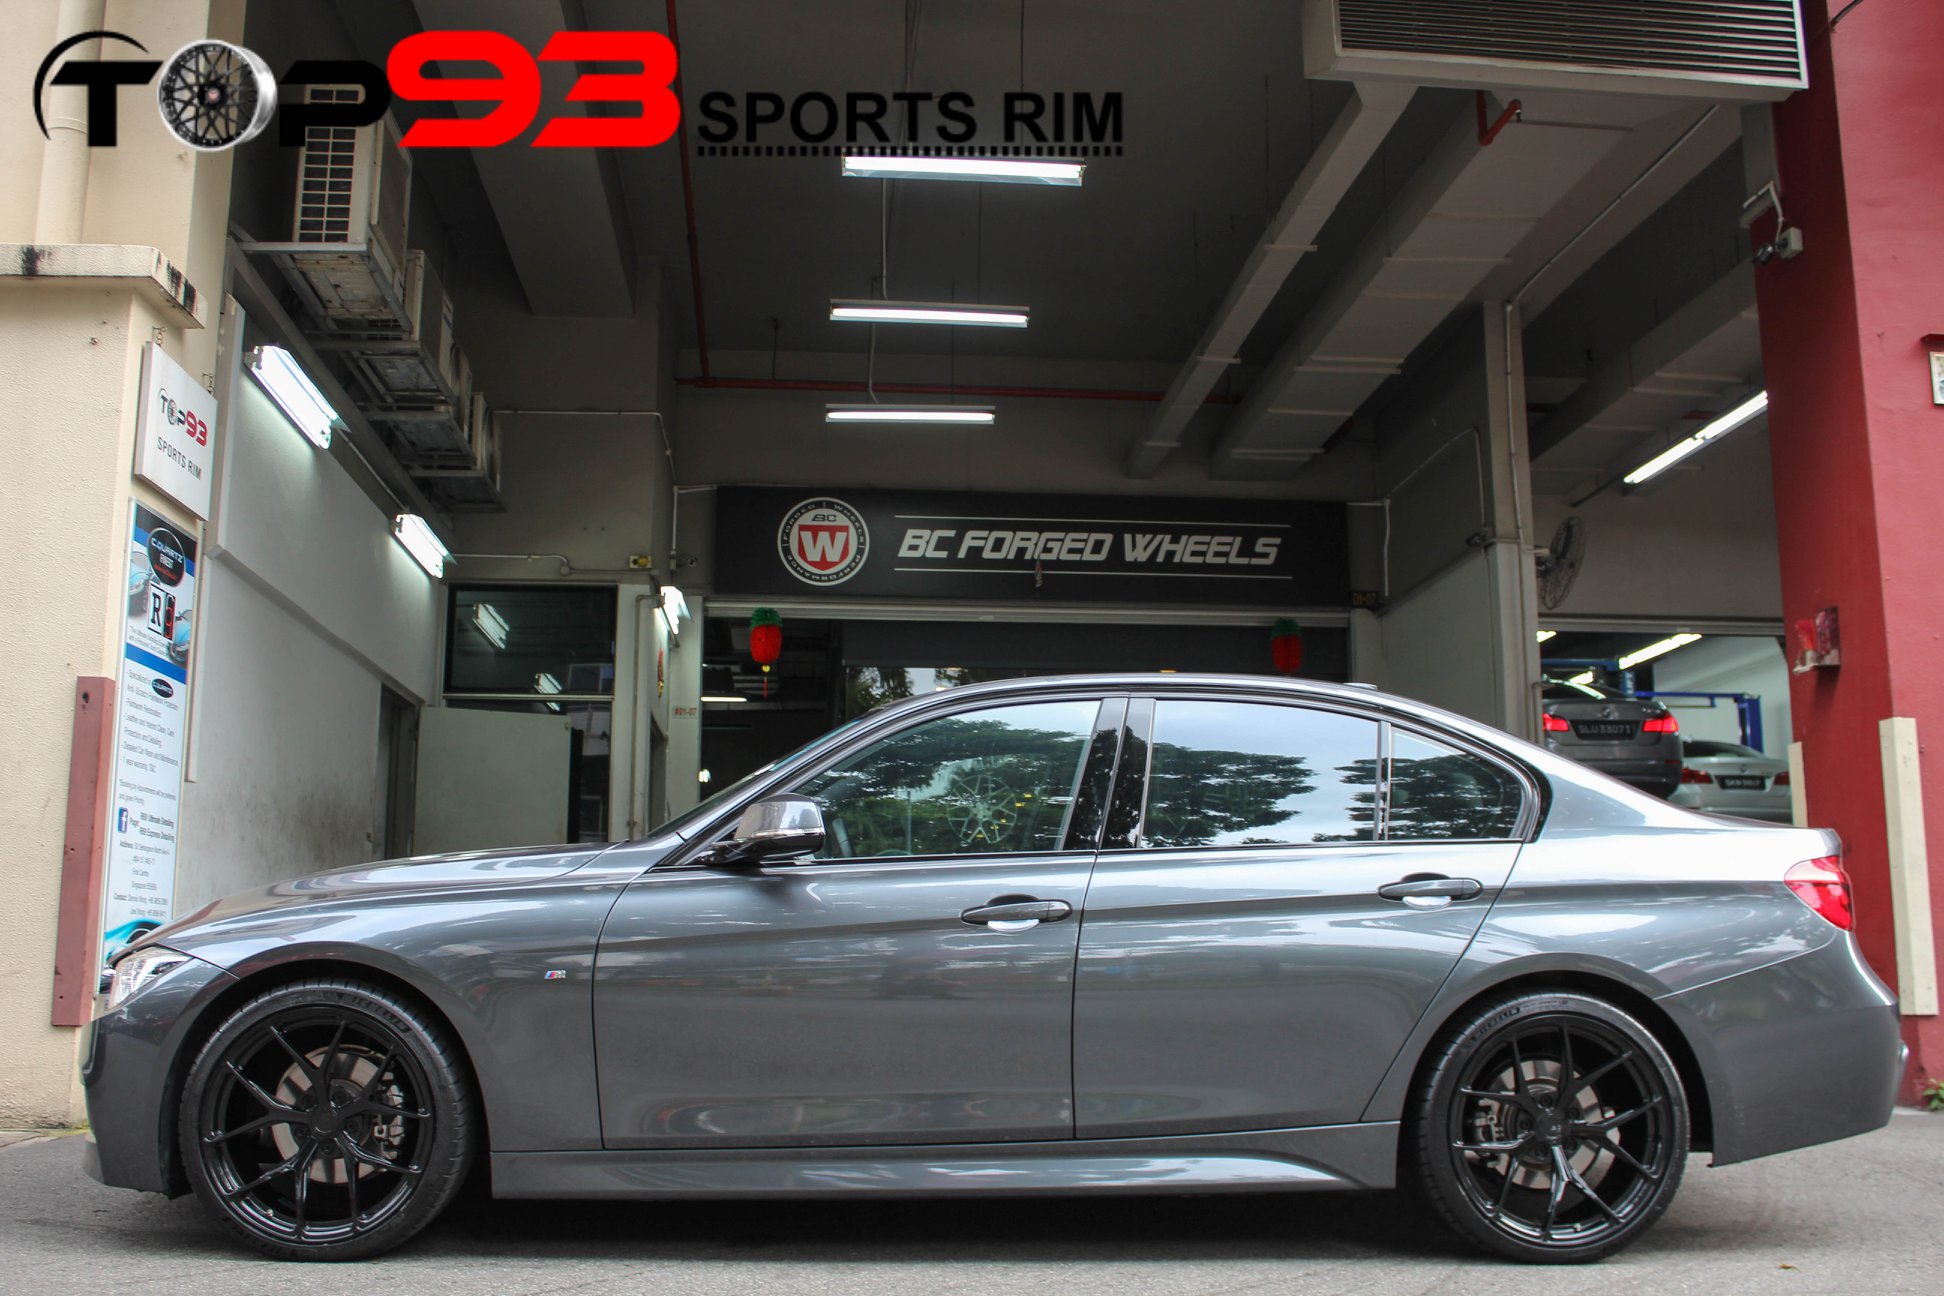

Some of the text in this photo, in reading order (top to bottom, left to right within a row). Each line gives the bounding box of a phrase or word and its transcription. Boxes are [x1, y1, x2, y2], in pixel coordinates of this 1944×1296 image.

[158, 389, 208, 447] TOP93
[157, 437, 202, 480] SPORTS RIM
[782, 503, 864, 543] FORGED WHEELS
[811, 513, 837, 522] BC
[799, 531, 848, 562] W
[897, 529, 1282, 566] BC FORGED WHEELS
